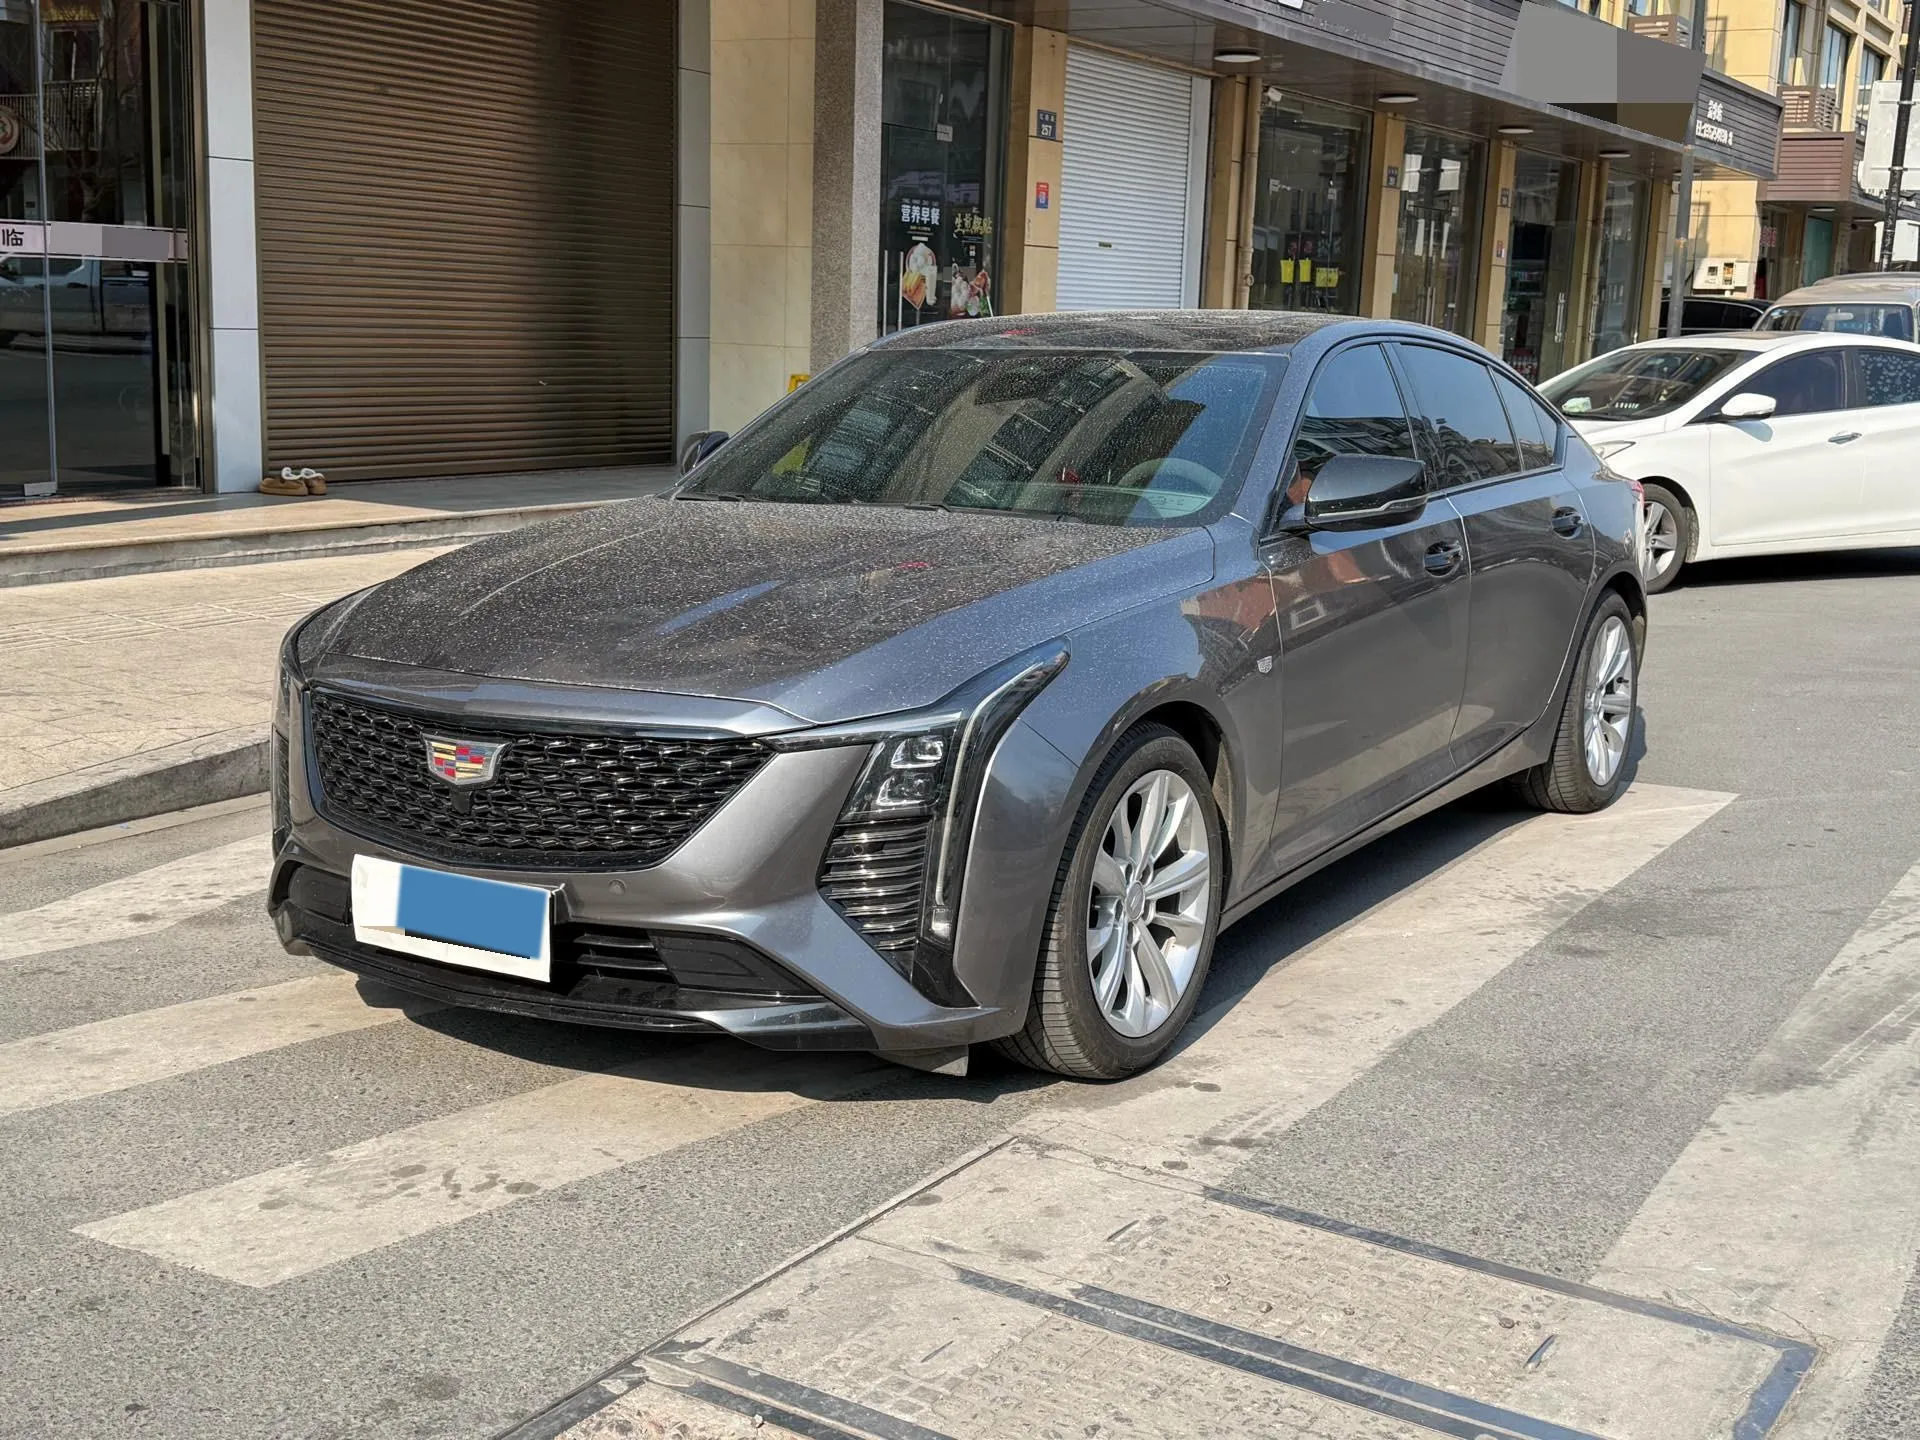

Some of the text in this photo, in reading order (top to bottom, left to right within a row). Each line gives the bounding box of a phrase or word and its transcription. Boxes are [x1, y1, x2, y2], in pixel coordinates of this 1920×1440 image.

[901, 204, 940, 225] 营养早餐
[2, 228, 24, 246] 临
